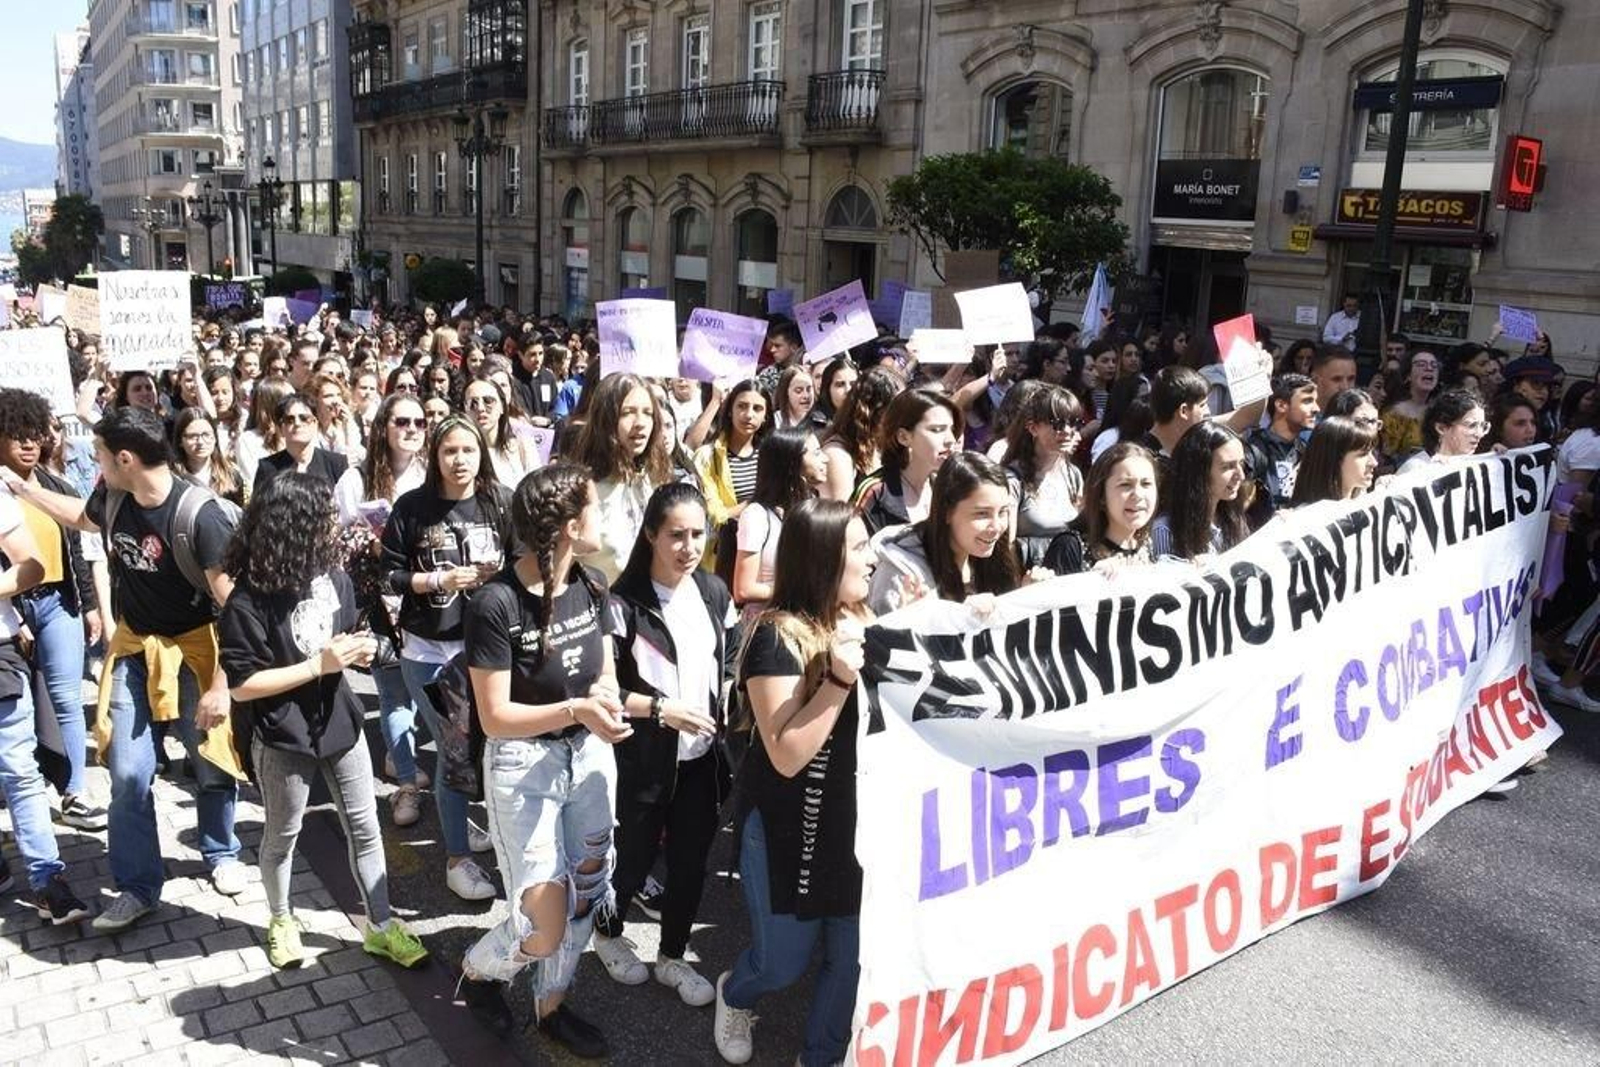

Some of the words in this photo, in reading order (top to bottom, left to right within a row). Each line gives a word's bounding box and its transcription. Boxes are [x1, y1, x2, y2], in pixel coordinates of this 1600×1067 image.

[1389, 88, 1455, 104] STRERÍA
[1173, 182, 1204, 195] MARÍA
[1206, 185, 1241, 196] BONET
[859, 561, 1275, 736] FEMINISMO
[1277, 447, 1556, 632] ANTICPITALIST
[918, 727, 1206, 902] LIBRES
[1265, 672, 1304, 772] E
[1258, 824, 1343, 931] DE
